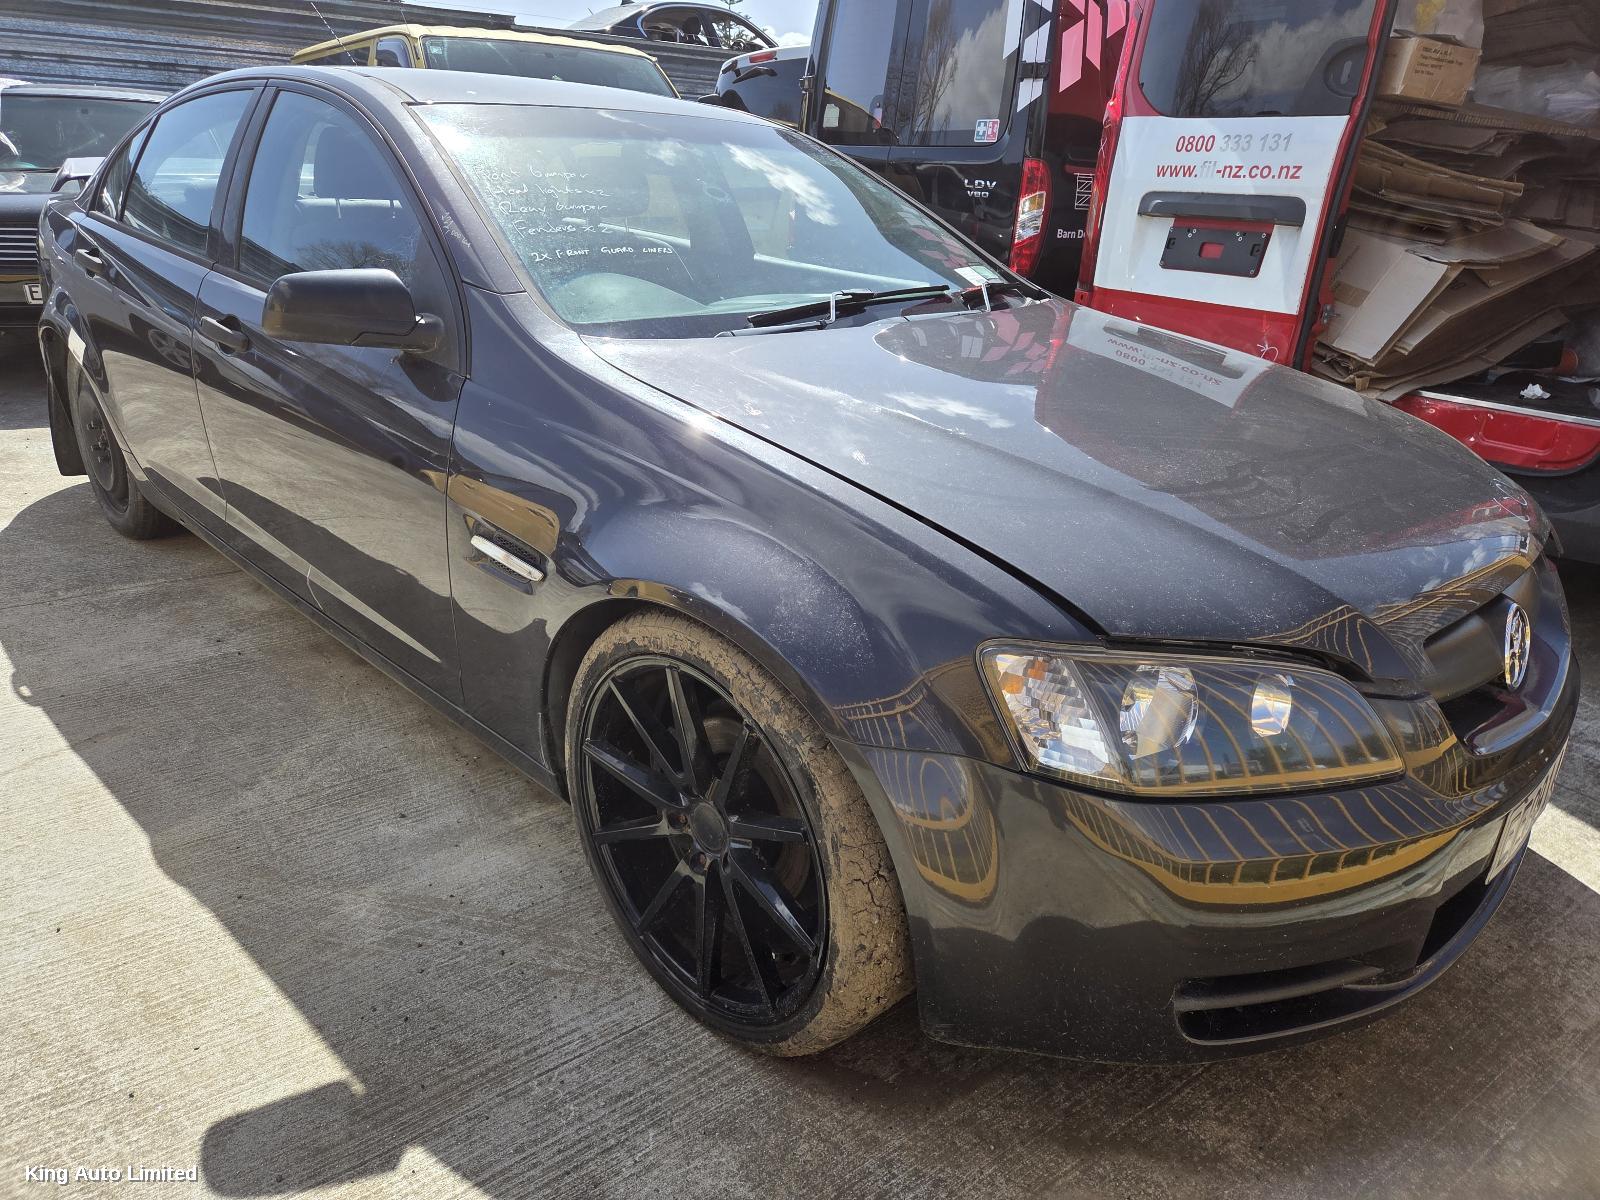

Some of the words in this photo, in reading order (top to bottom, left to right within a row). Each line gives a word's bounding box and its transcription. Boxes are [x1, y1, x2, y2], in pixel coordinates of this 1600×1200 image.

[1175, 134, 1216, 152] 0800
[1219, 134, 1253, 152] 333
[1259, 133, 1293, 152] 131
[1156, 160, 1303, 179] www.fil-nz.co.nz
[964, 178, 997, 189] LDV
[1056, 228, 1076, 239] Barn
[1077, 229, 1086, 239] D
